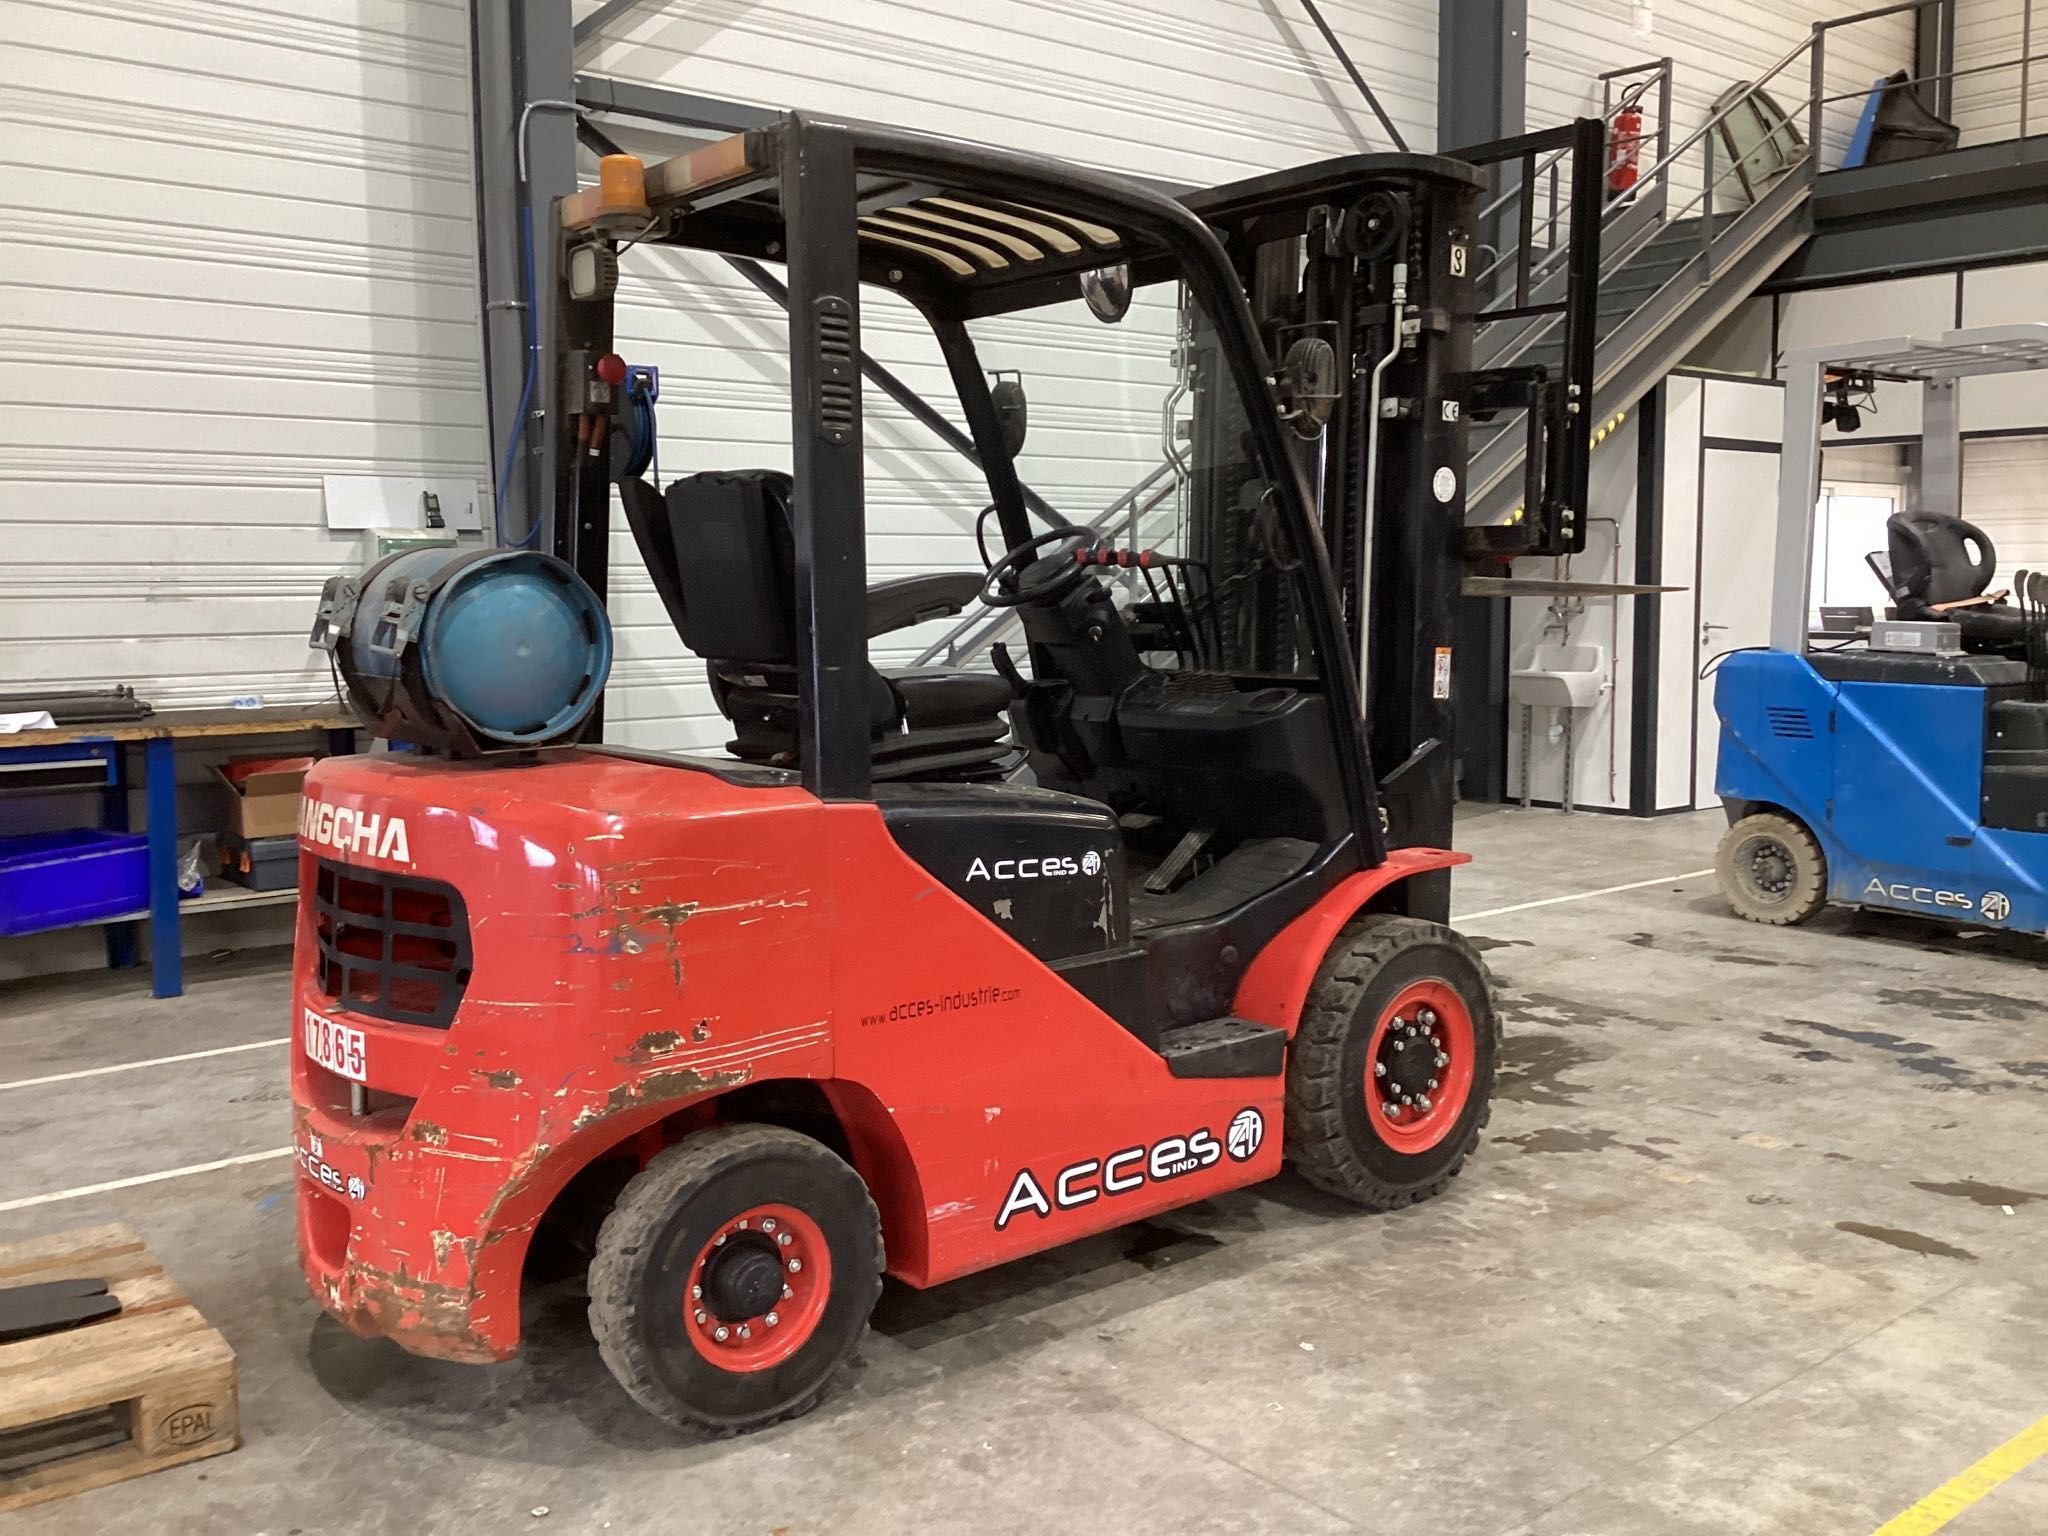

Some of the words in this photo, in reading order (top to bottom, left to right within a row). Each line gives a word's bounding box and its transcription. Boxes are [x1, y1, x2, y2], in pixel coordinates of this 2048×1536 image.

[299, 796, 410, 864] ANGCHA
[966, 856, 1078, 883] Acces
[1864, 877, 1973, 909] Acces
[860, 985, 1021, 1027] www.acces-industrie.com
[306, 1014, 362, 1075] 17865
[995, 1127, 1221, 1231] Acces
[1171, 1157, 1199, 1174] IND
